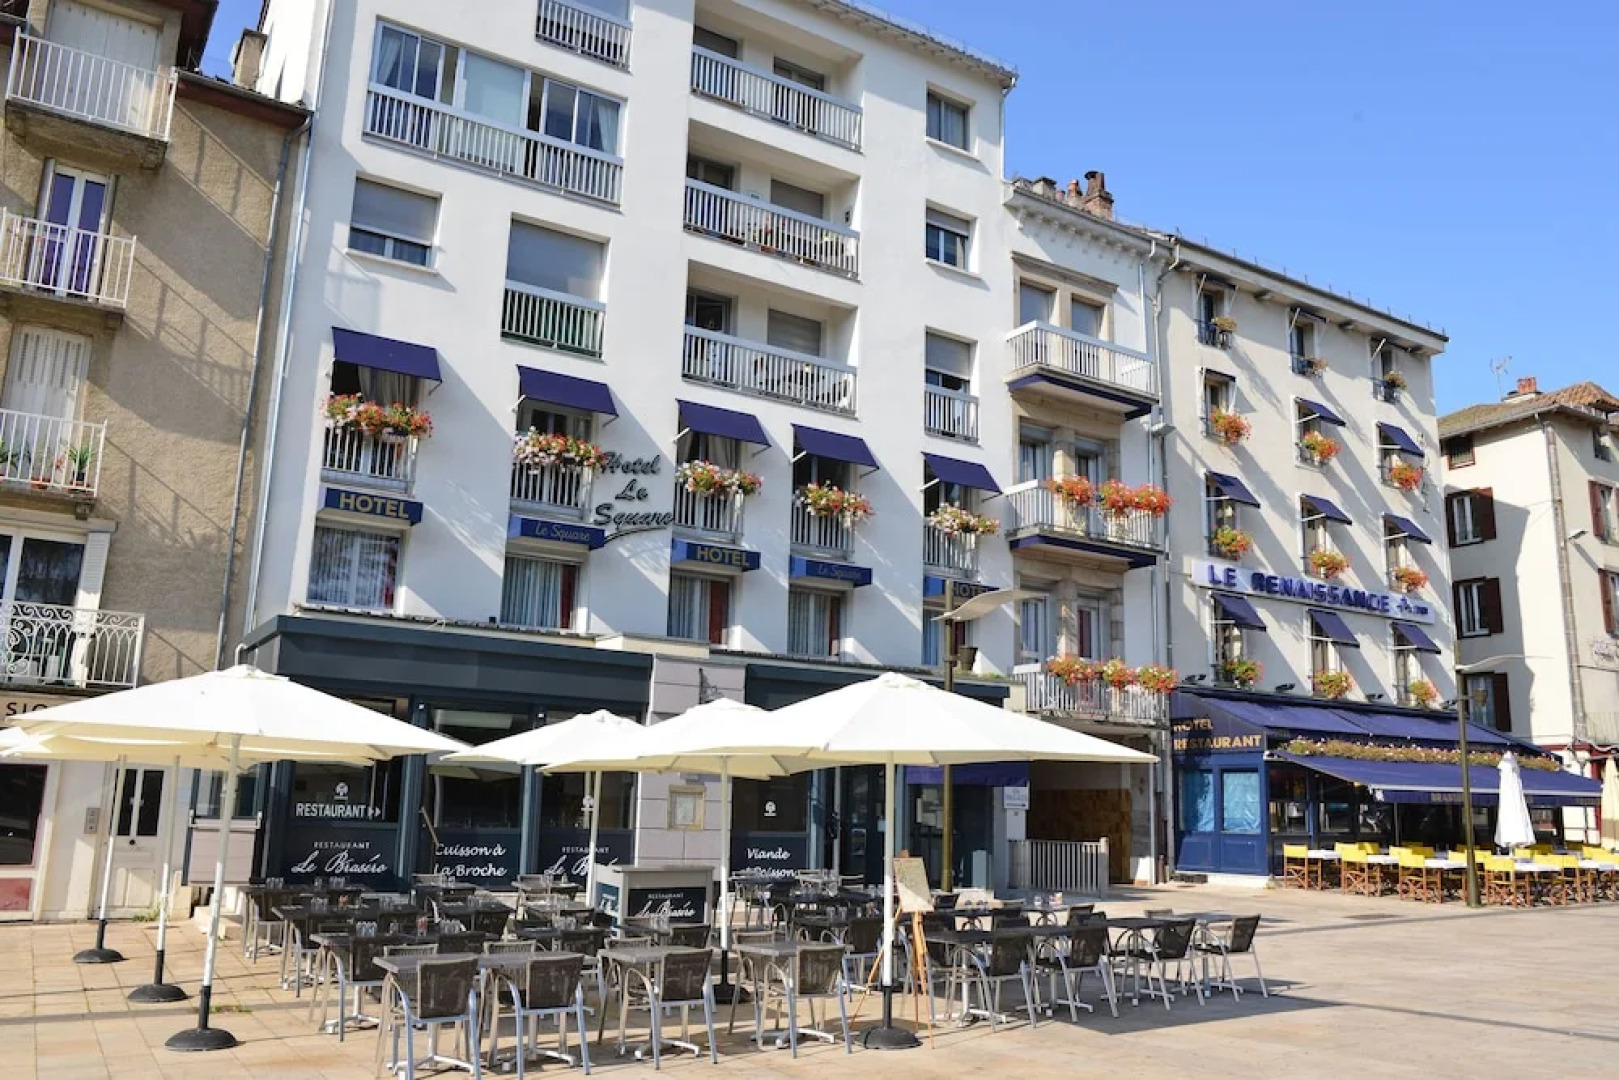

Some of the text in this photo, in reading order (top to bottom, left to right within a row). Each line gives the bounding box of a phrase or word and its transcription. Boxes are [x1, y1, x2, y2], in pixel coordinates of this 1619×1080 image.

[601, 452, 660, 474] Hotel
[615, 479, 648, 501] Le
[340, 491, 409, 519] HOTEL
[594, 503, 675, 531] Square
[536, 522, 590, 541] Le Square
[697, 546, 749, 566] HOTEL
[1207, 565, 1390, 613] LE RENAISSANCE
[1173, 734, 1262, 751] RESTAURANT
[295, 803, 366, 818] RESTAURANT
[313, 841, 370, 849] RESTAURANT
[435, 843, 492, 857] Cuisson
[561, 846, 610, 854] RESTAUANT
[747, 846, 791, 859] Viande
[291, 849, 319, 873] Le
[454, 862, 508, 877] Broche
